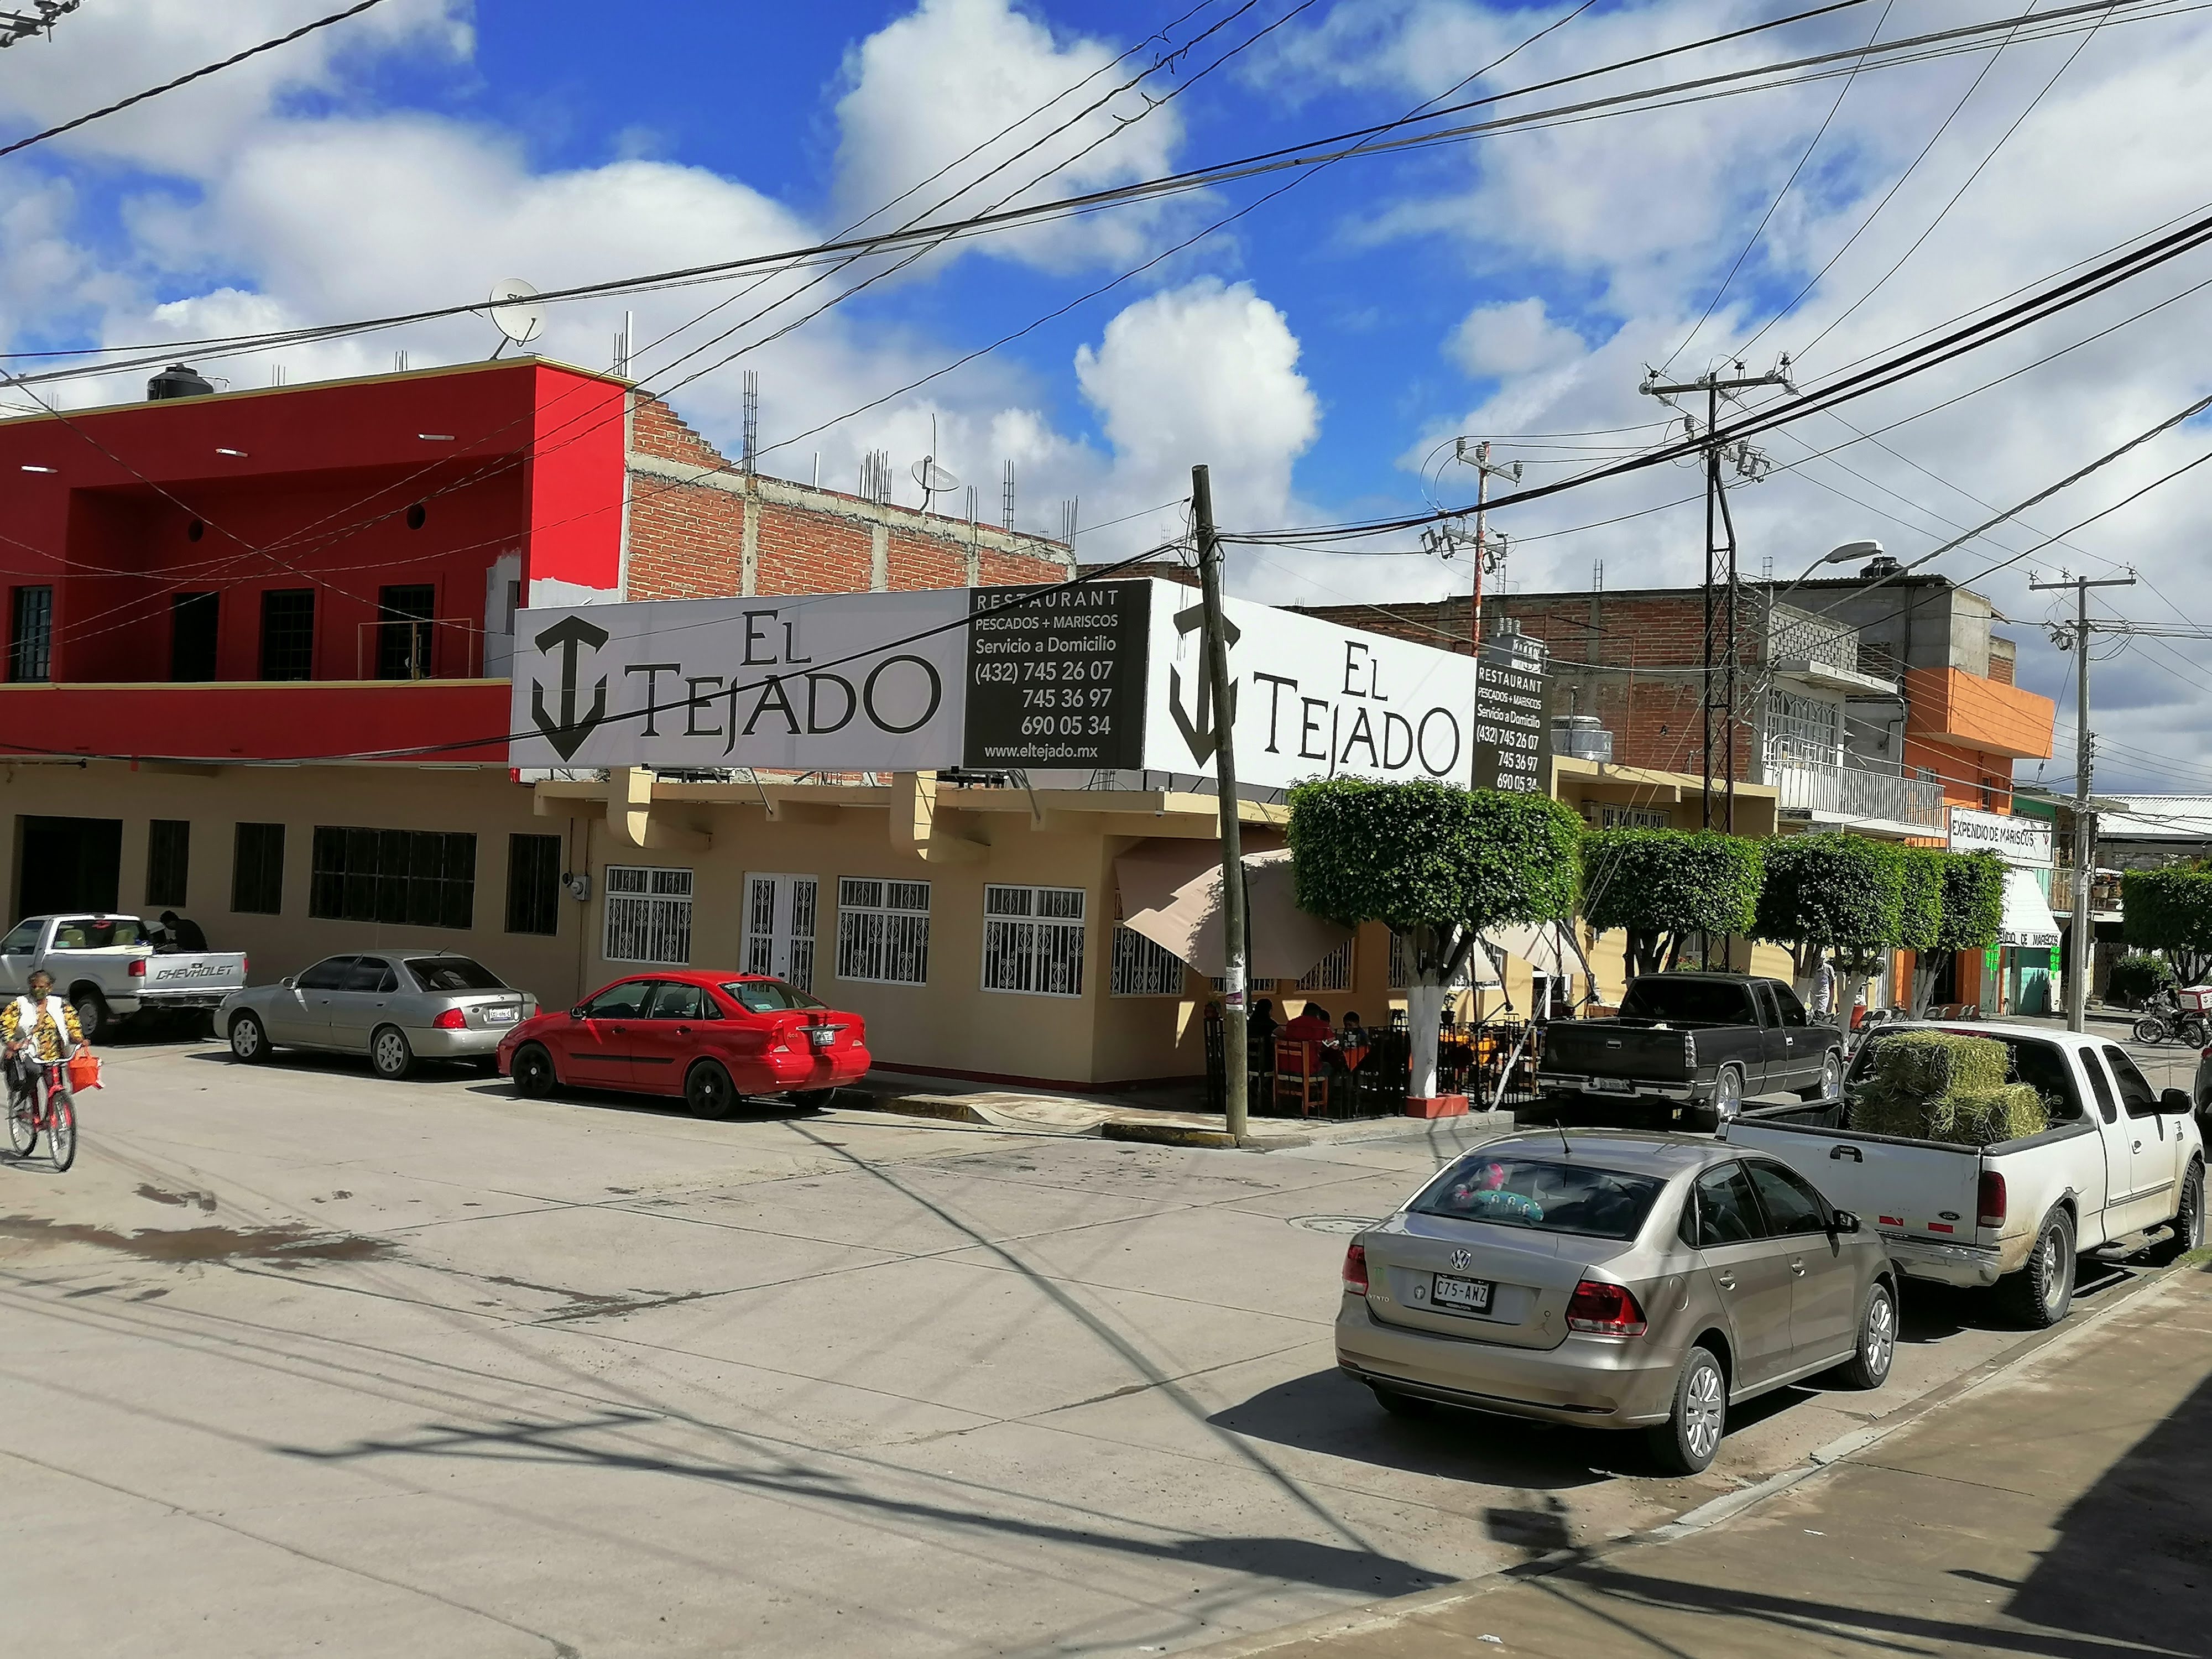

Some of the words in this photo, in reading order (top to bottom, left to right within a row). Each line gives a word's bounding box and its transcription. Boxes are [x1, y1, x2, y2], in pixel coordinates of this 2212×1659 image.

[975, 617, 1039, 631] PESCADOS
[1053, 614, 1118, 629] MARISCOS
[740, 610, 812, 667] EL
[975, 638, 1031, 654] Servicio
[1035, 641, 1044, 653] a
[1048, 635, 1117, 653] Domicilio
[975, 662, 1018, 685] (432)
[1024, 662, 1056, 681] 745
[1062, 661, 1085, 680] 26
[1091, 661, 1114, 680] 07
[1342, 640, 1388, 702] EL
[1478, 666, 1543, 693] RESTAURANT
[624, 654, 942, 757] TEJADO
[1022, 689, 1055, 708] 745
[1061, 688, 1083, 707] 36
[1089, 688, 1112, 707] 97
[1021, 716, 1055, 735] 690
[1060, 716, 1082, 735] 05
[1088, 716, 1111, 735] 34
[1254, 671, 1460, 780] TEJADO
[1477, 724, 1498, 745] (432)
[1499, 728, 1515, 747] 745
[1516, 732, 1527, 749] 26
[1528, 734, 1539, 750] 07
[984, 742, 1098, 761] www.eltejado.mx
[1498, 750, 1514, 768] 745
[1515, 754, 1526, 770] 36
[1527, 756, 1538, 771] 97
[1497, 773, 1513, 790] 690
[1514, 775, 1525, 791] 05
[1952, 820, 1989, 841] EXPENDIO
[1990, 826, 1999, 842] DE
[2000, 828, 2034, 847] MARISCOS
[155, 964, 234, 980] CHEVROLET
